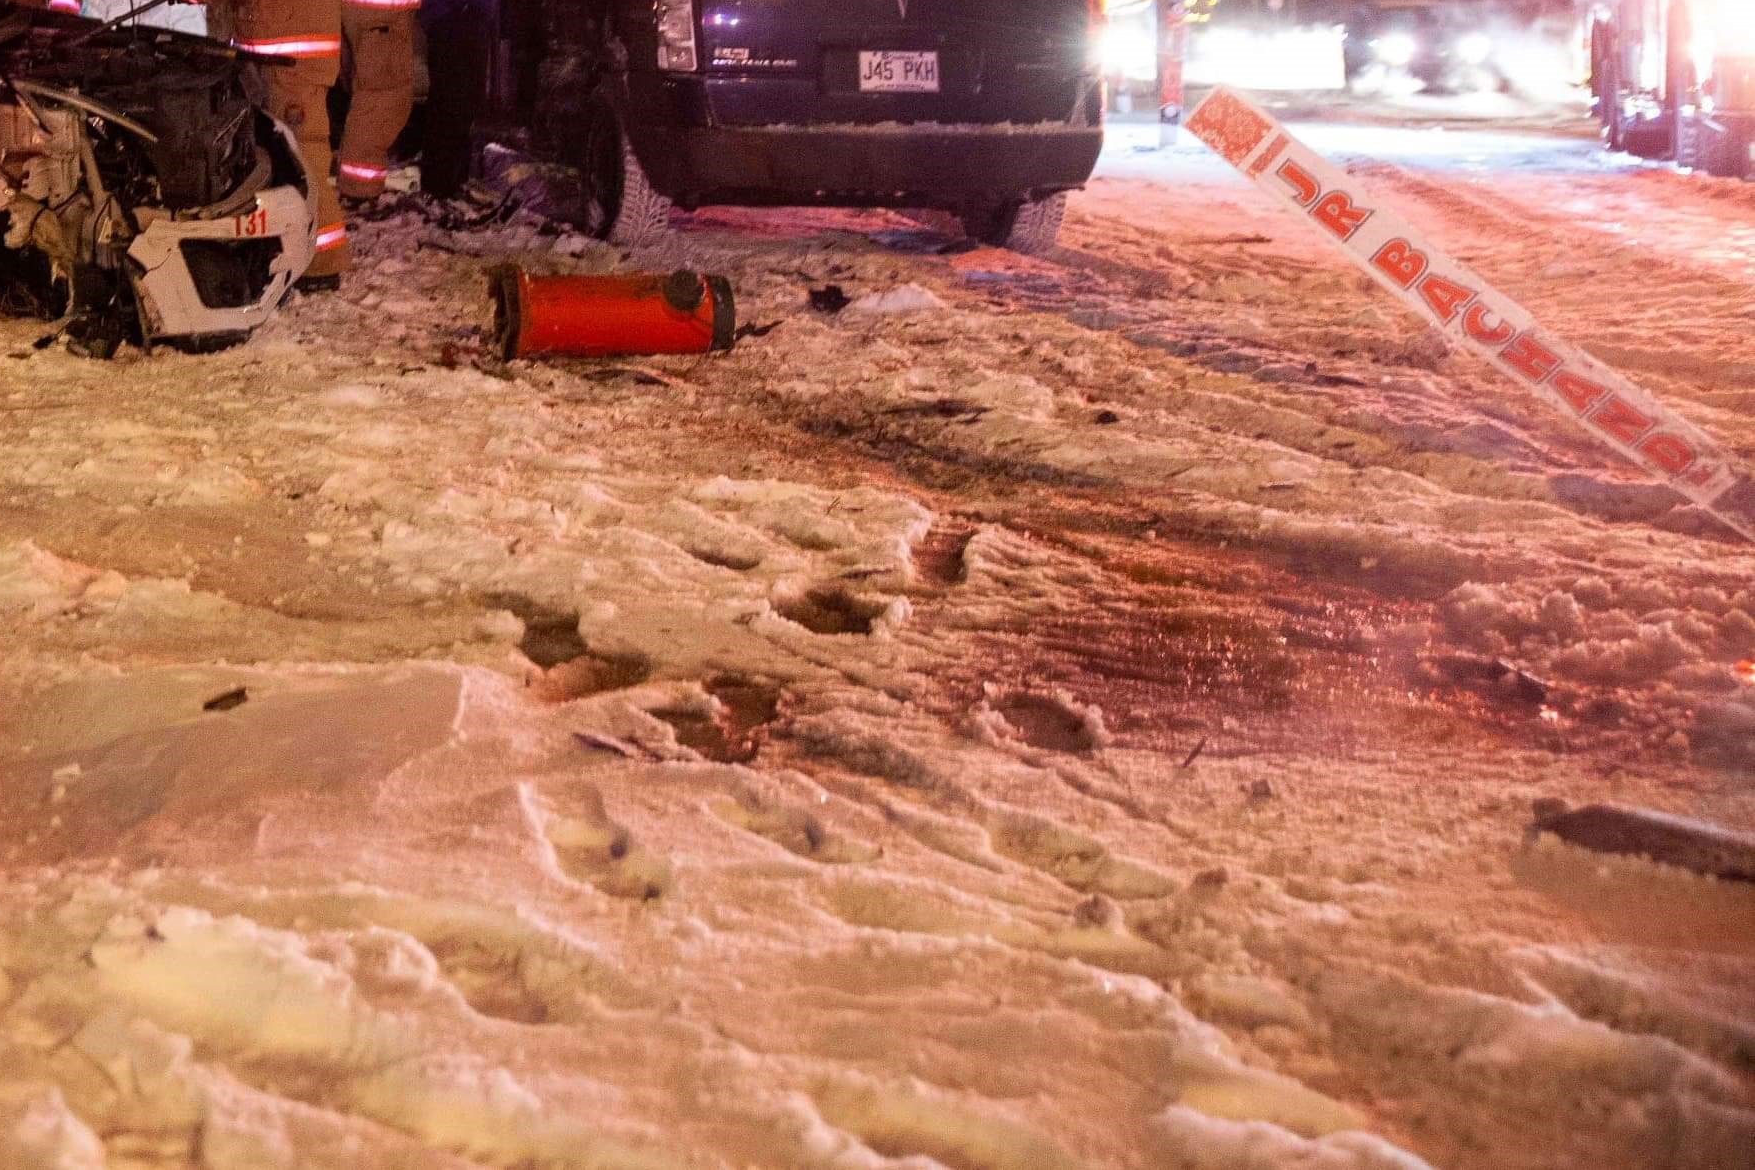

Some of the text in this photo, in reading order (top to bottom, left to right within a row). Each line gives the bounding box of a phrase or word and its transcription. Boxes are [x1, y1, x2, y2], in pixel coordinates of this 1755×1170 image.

[864, 60, 936, 81] J45 PKH
[1277, 158, 1695, 478] JR BACHAND
